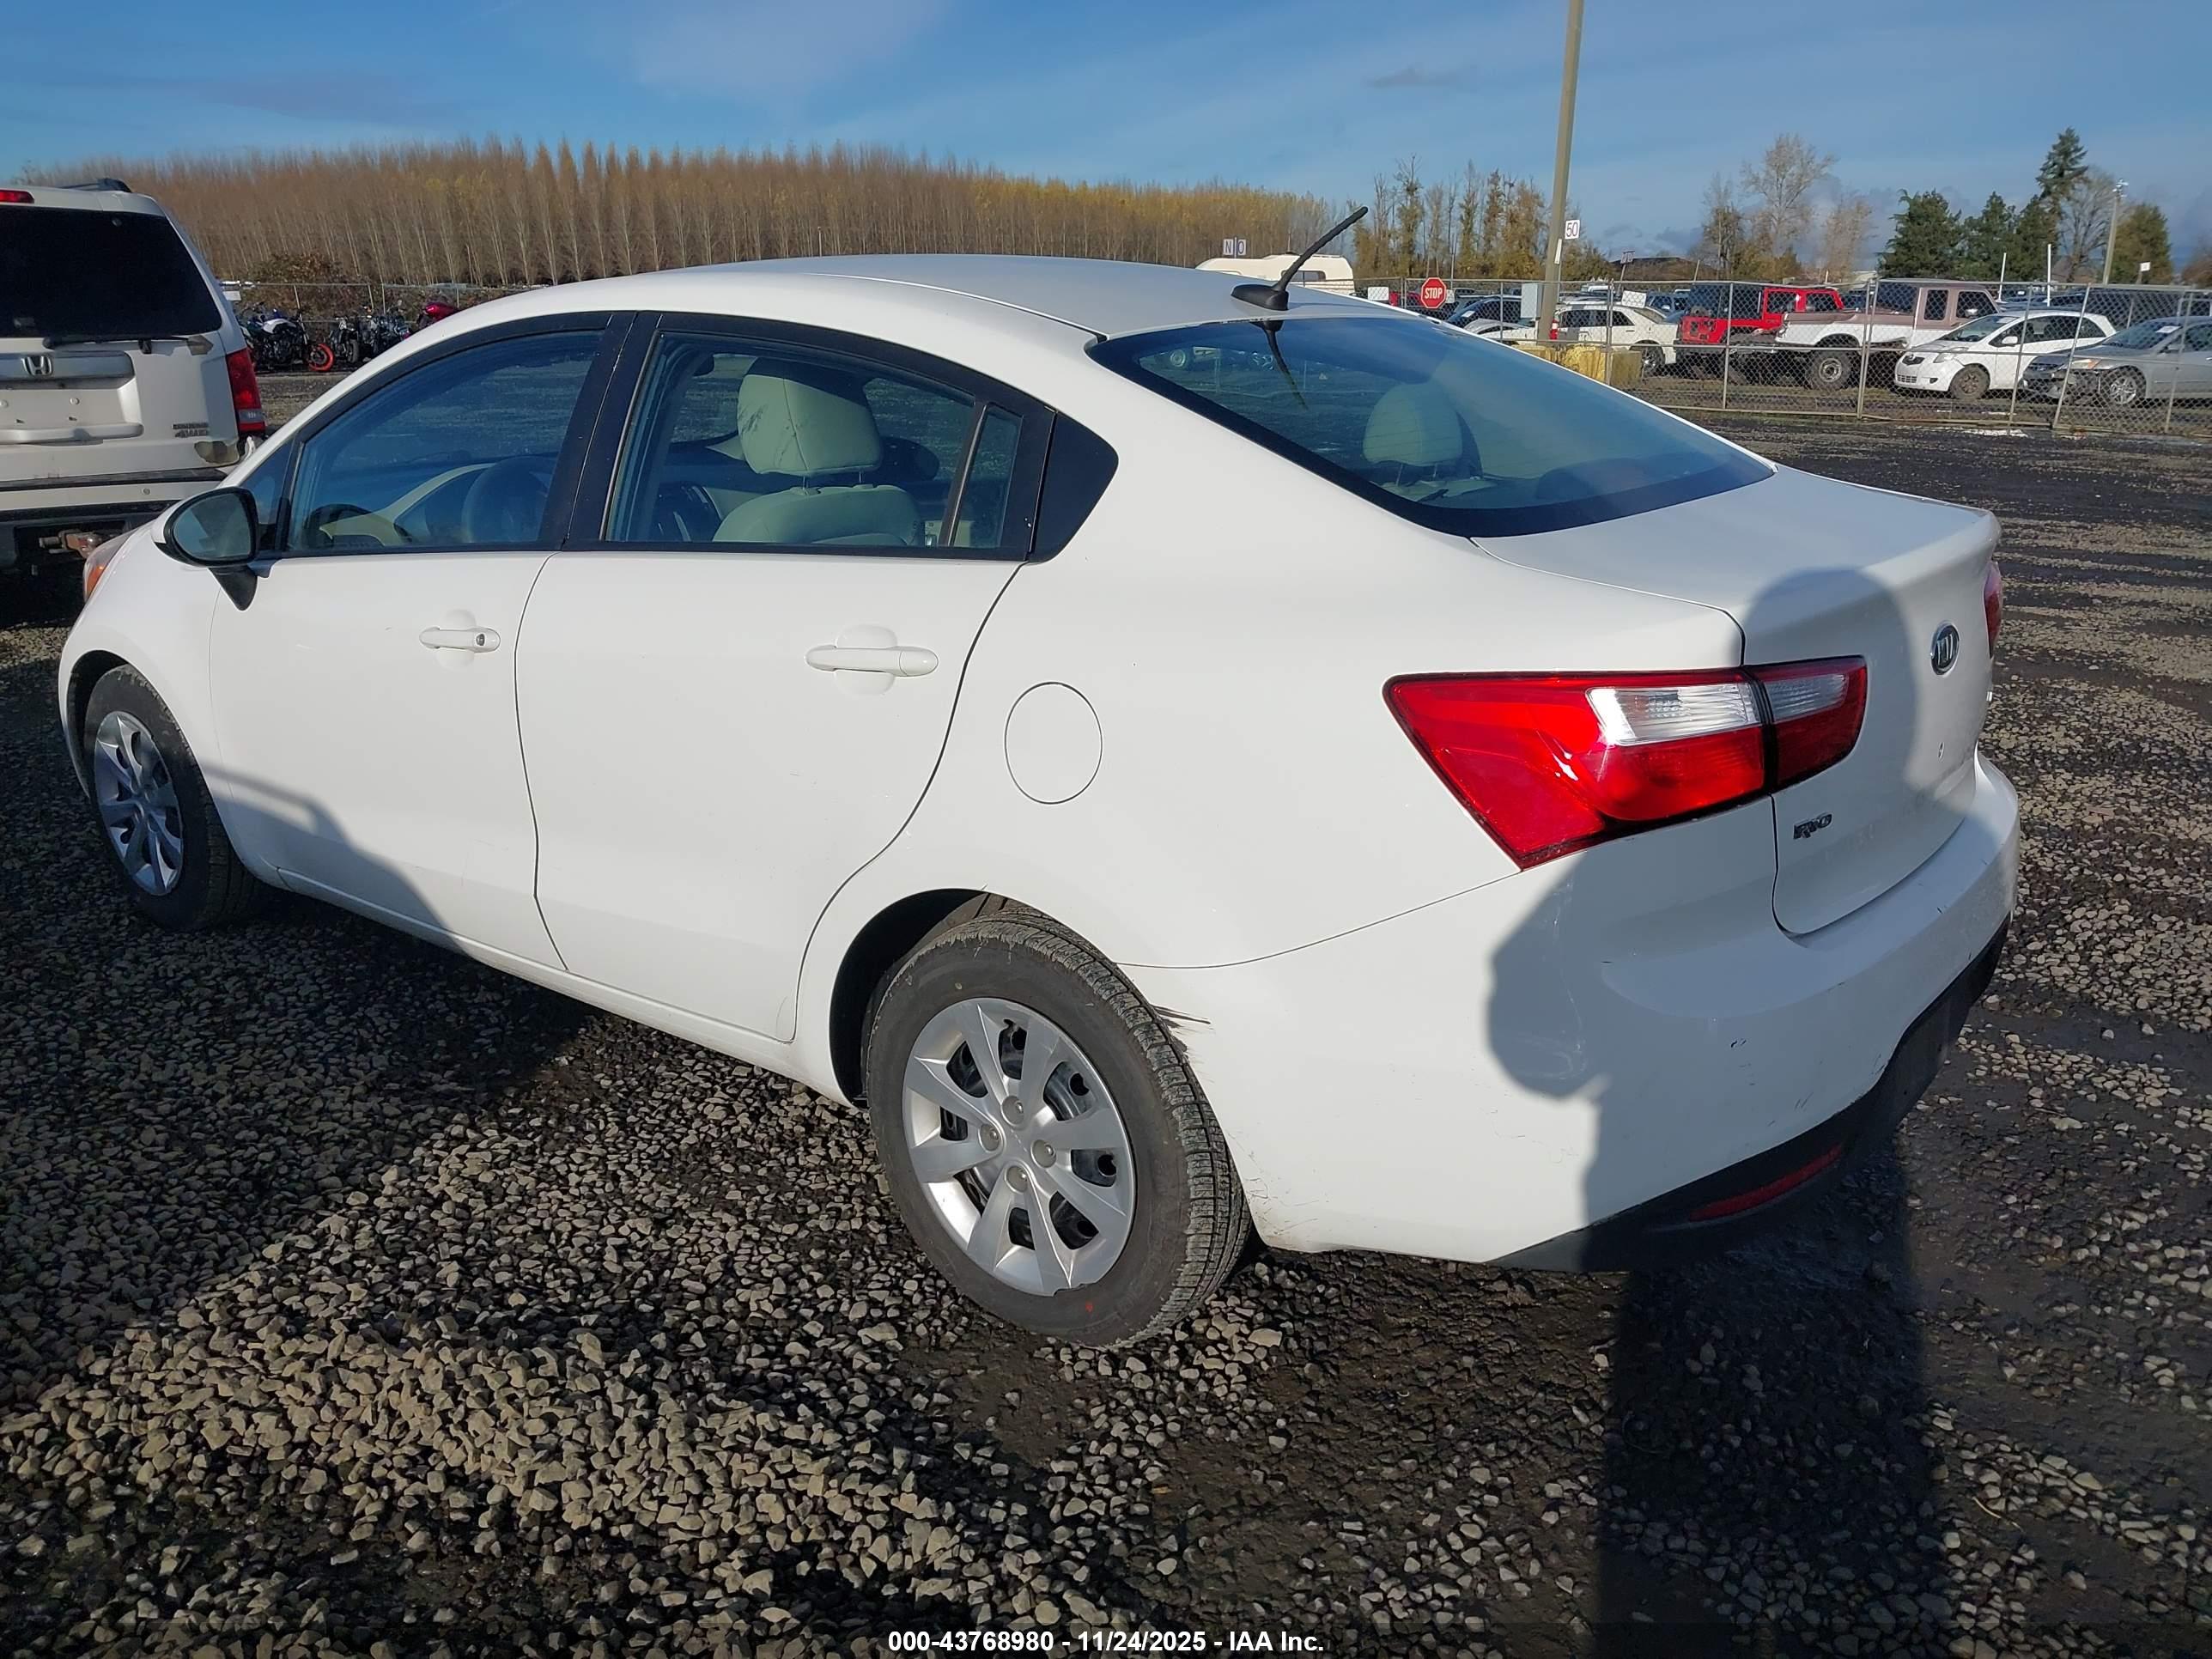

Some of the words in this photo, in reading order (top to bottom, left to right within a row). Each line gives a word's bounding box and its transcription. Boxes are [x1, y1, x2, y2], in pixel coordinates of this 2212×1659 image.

[1566, 222, 1578, 237] 50
[1225, 240, 1231, 253] N
[1424, 287, 1443, 299] STOP
